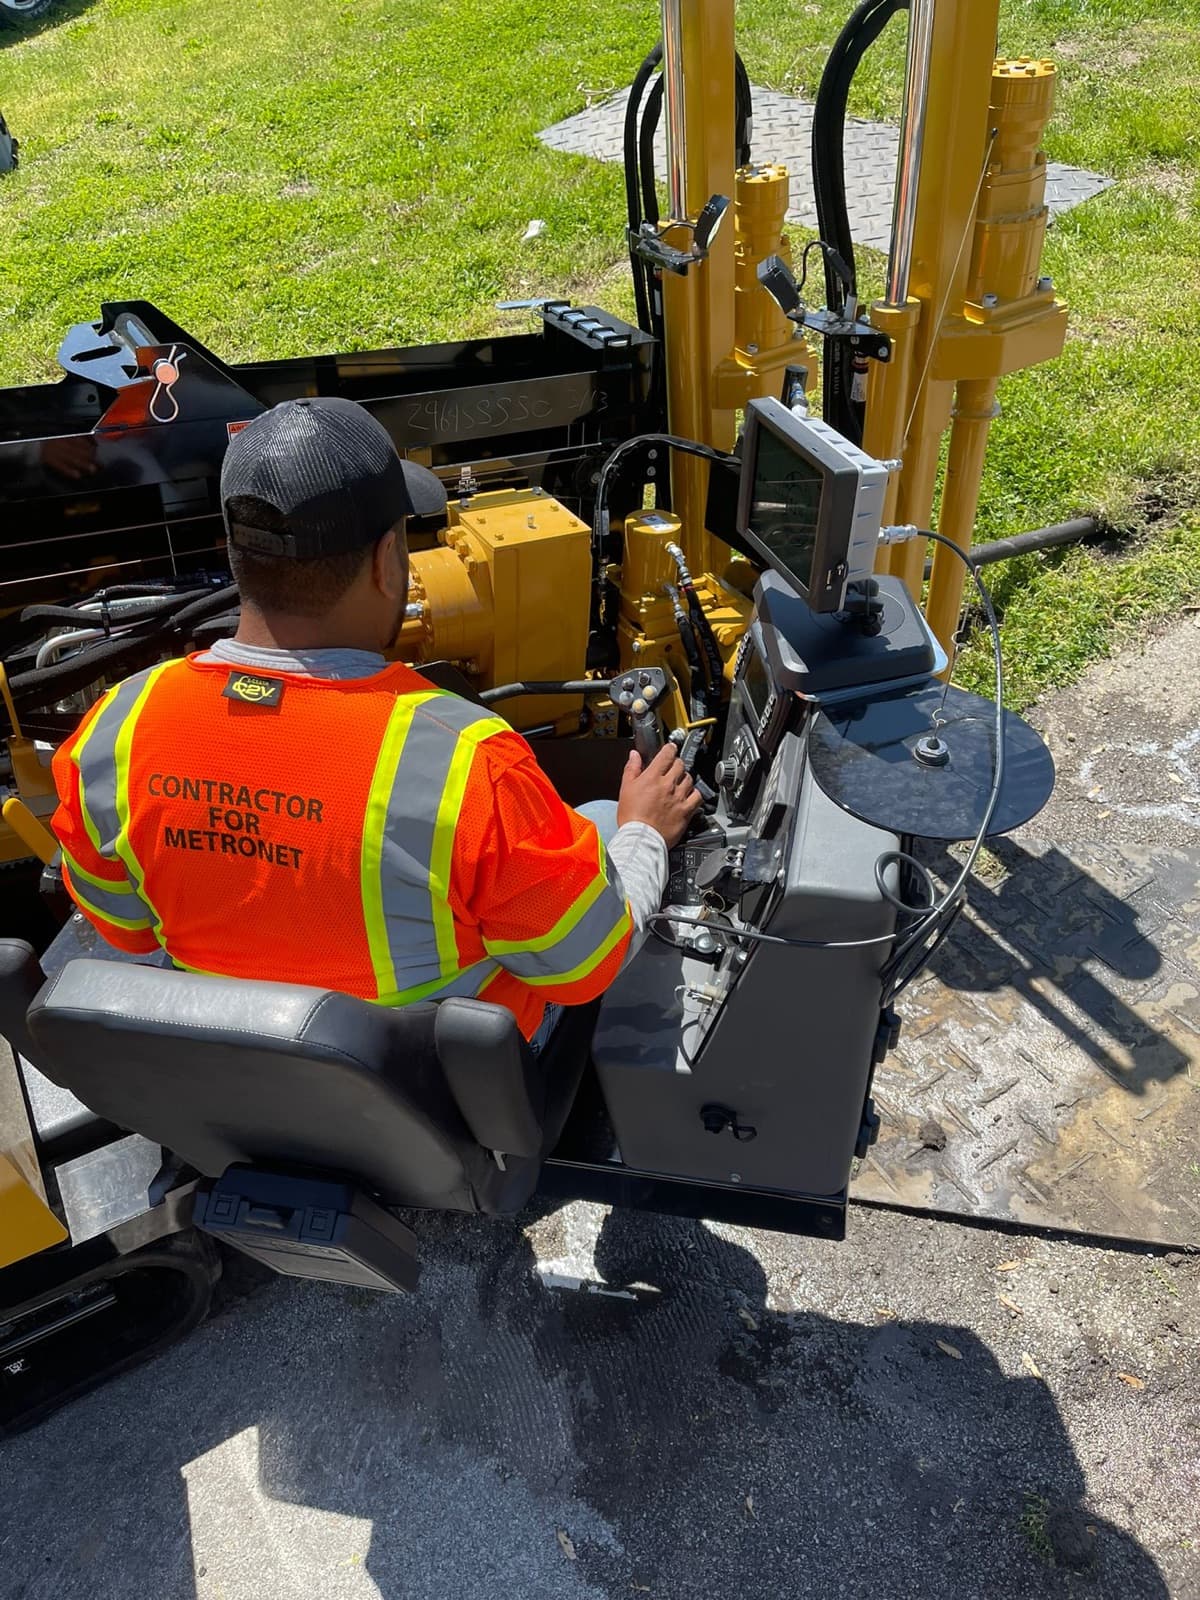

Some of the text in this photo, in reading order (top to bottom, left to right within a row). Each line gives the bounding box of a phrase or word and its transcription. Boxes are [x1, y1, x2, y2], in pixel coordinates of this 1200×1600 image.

[148, 773, 324, 823] CONTRACTOR
[209, 806, 260, 835] FOR
[164, 826, 303, 869] METRONET
